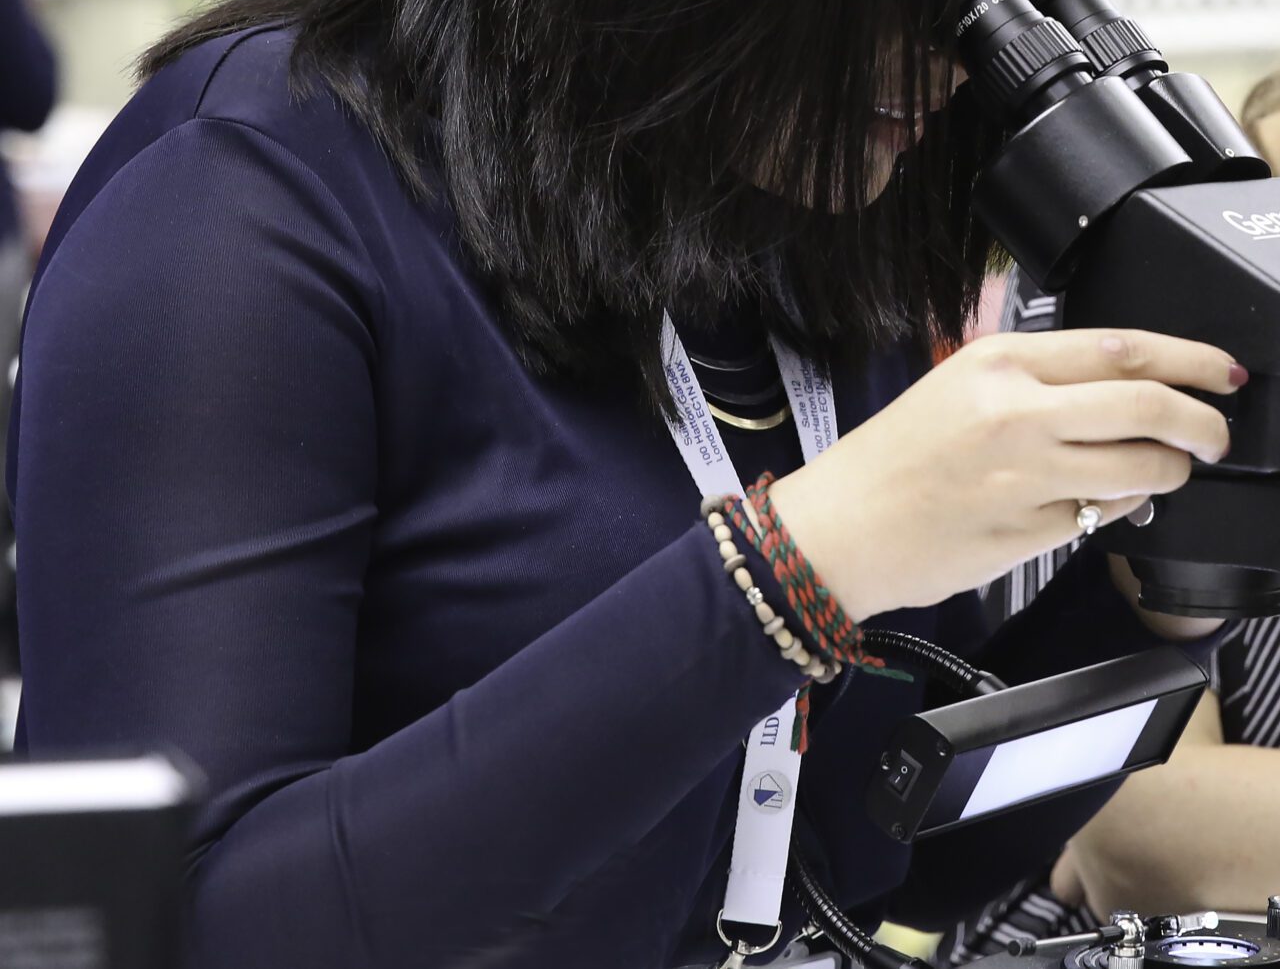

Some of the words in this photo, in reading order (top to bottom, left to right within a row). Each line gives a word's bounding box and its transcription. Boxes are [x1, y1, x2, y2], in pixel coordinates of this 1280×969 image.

[675, 359, 691, 384] 8NX
[686, 385, 705, 419] EC1N
[792, 380, 803, 398] 112
[685, 406, 704, 445] Hatton
[799, 402, 810, 429] Suite
[808, 396, 820, 432] Hatton
[678, 417, 693, 447] Suit
[702, 420, 724, 463] London
[699, 446, 713, 466] 100
